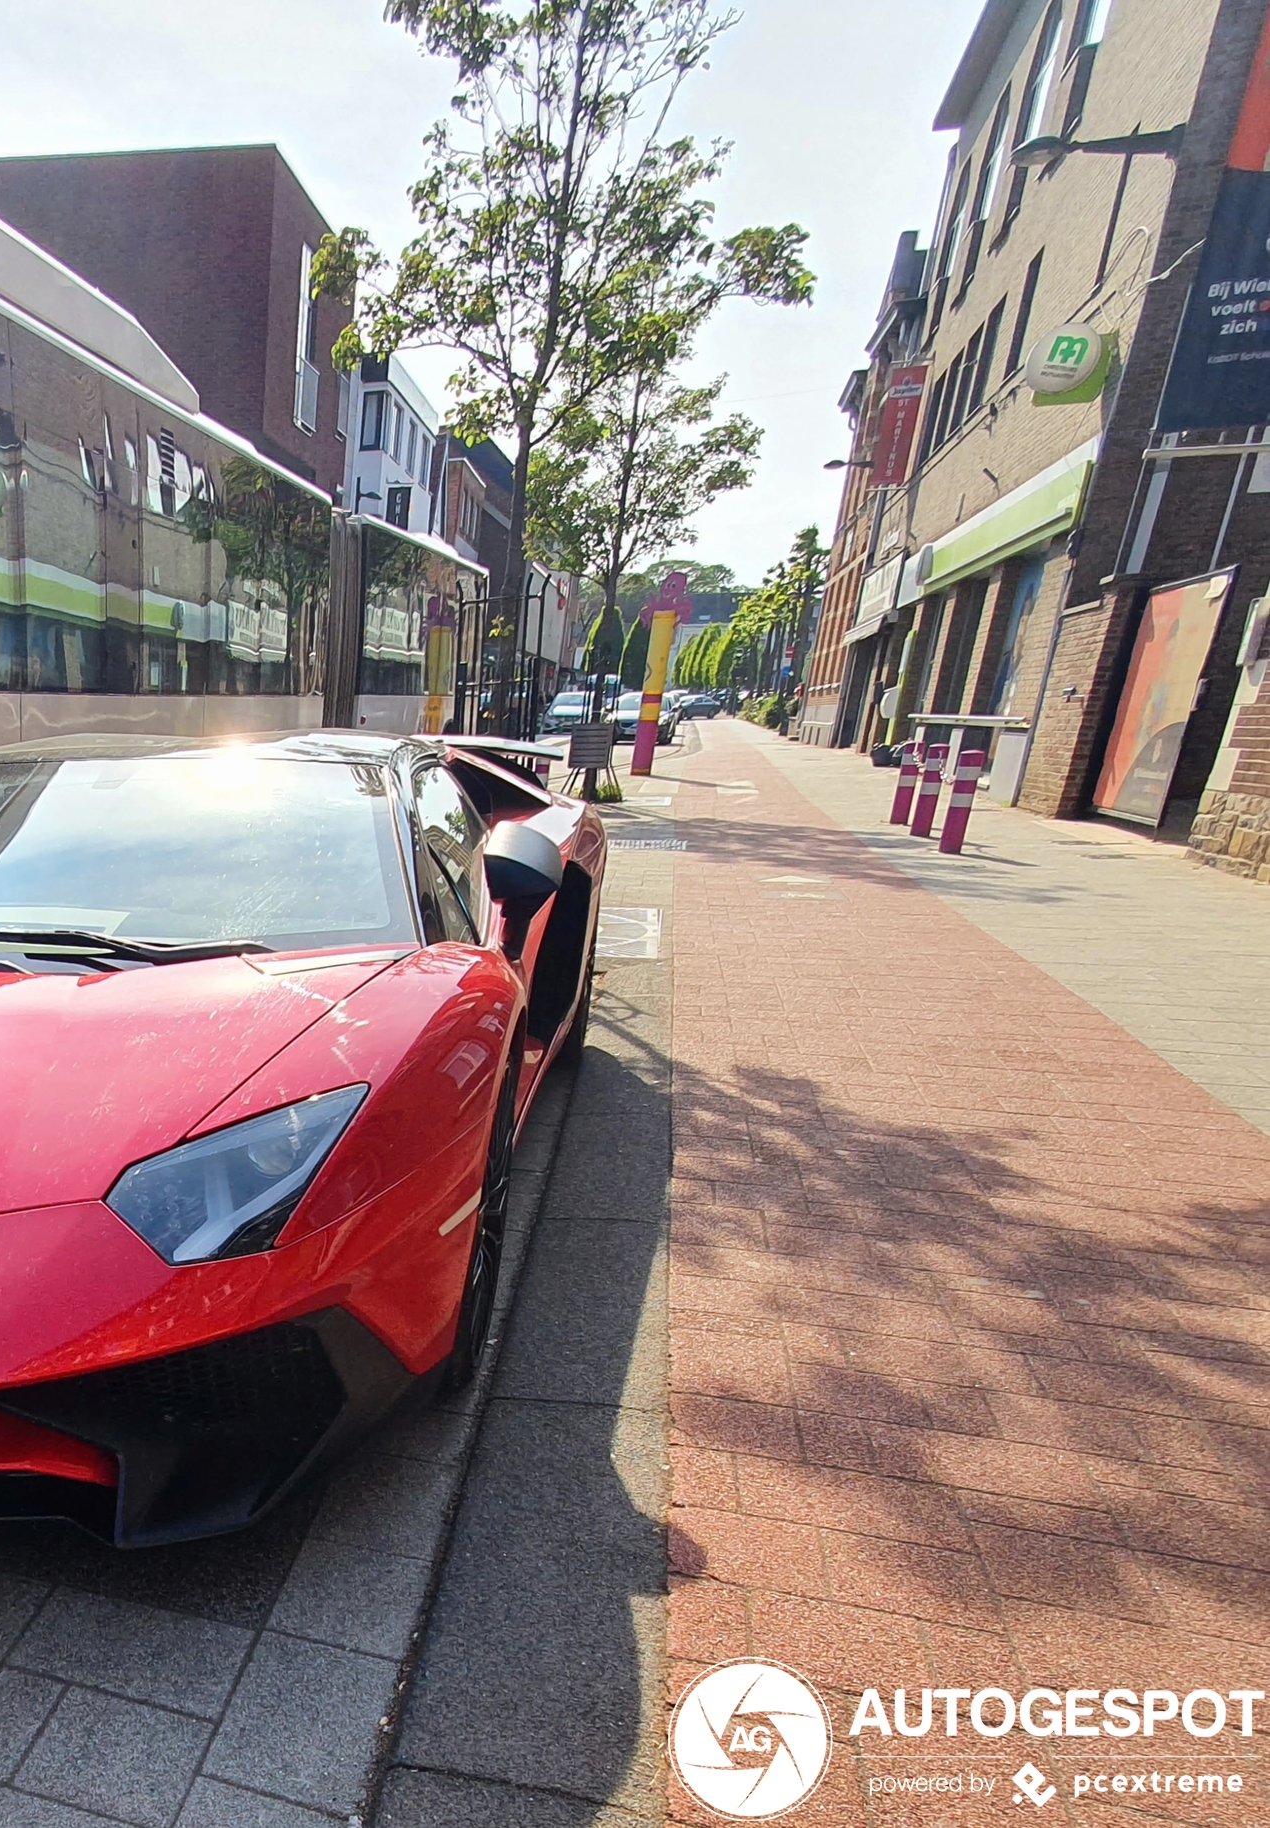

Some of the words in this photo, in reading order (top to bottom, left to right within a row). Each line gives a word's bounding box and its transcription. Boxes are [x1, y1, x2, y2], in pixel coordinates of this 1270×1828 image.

[1207, 281, 1231, 301] Bij
[1211, 299, 1257, 317] voelt
[1219, 319, 1258, 336] zich
